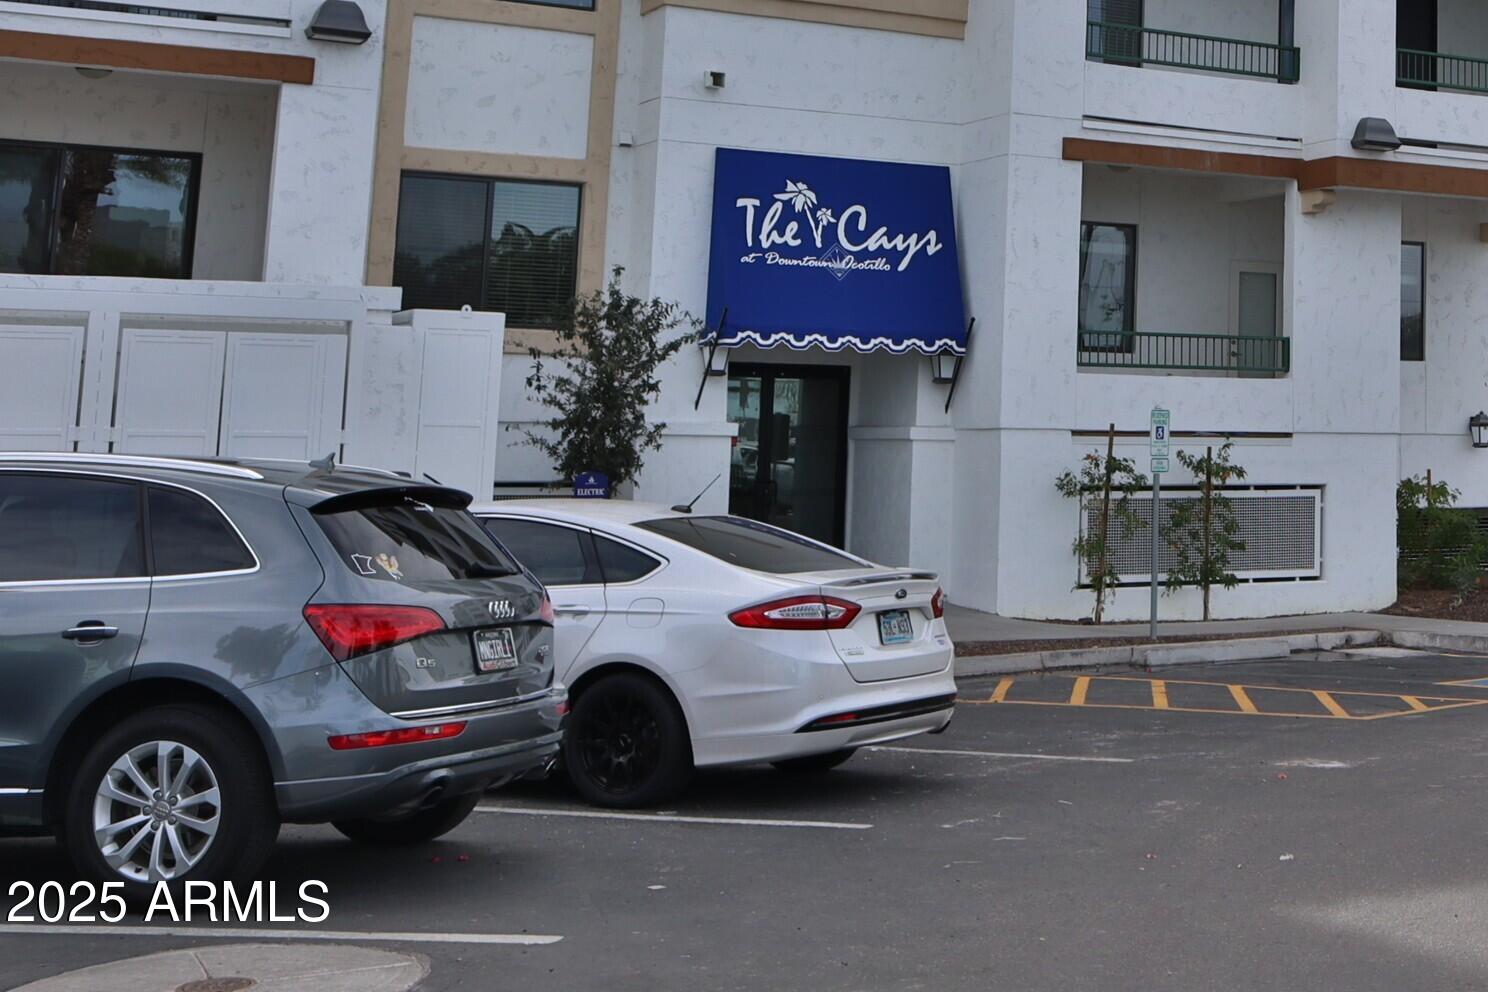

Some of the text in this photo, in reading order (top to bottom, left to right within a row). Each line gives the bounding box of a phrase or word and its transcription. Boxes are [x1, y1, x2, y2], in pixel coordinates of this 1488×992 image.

[736, 197, 943, 272] The Cays
[740, 251, 892, 272] at Downtown Ocotillo
[416, 657, 437, 668] Q5
